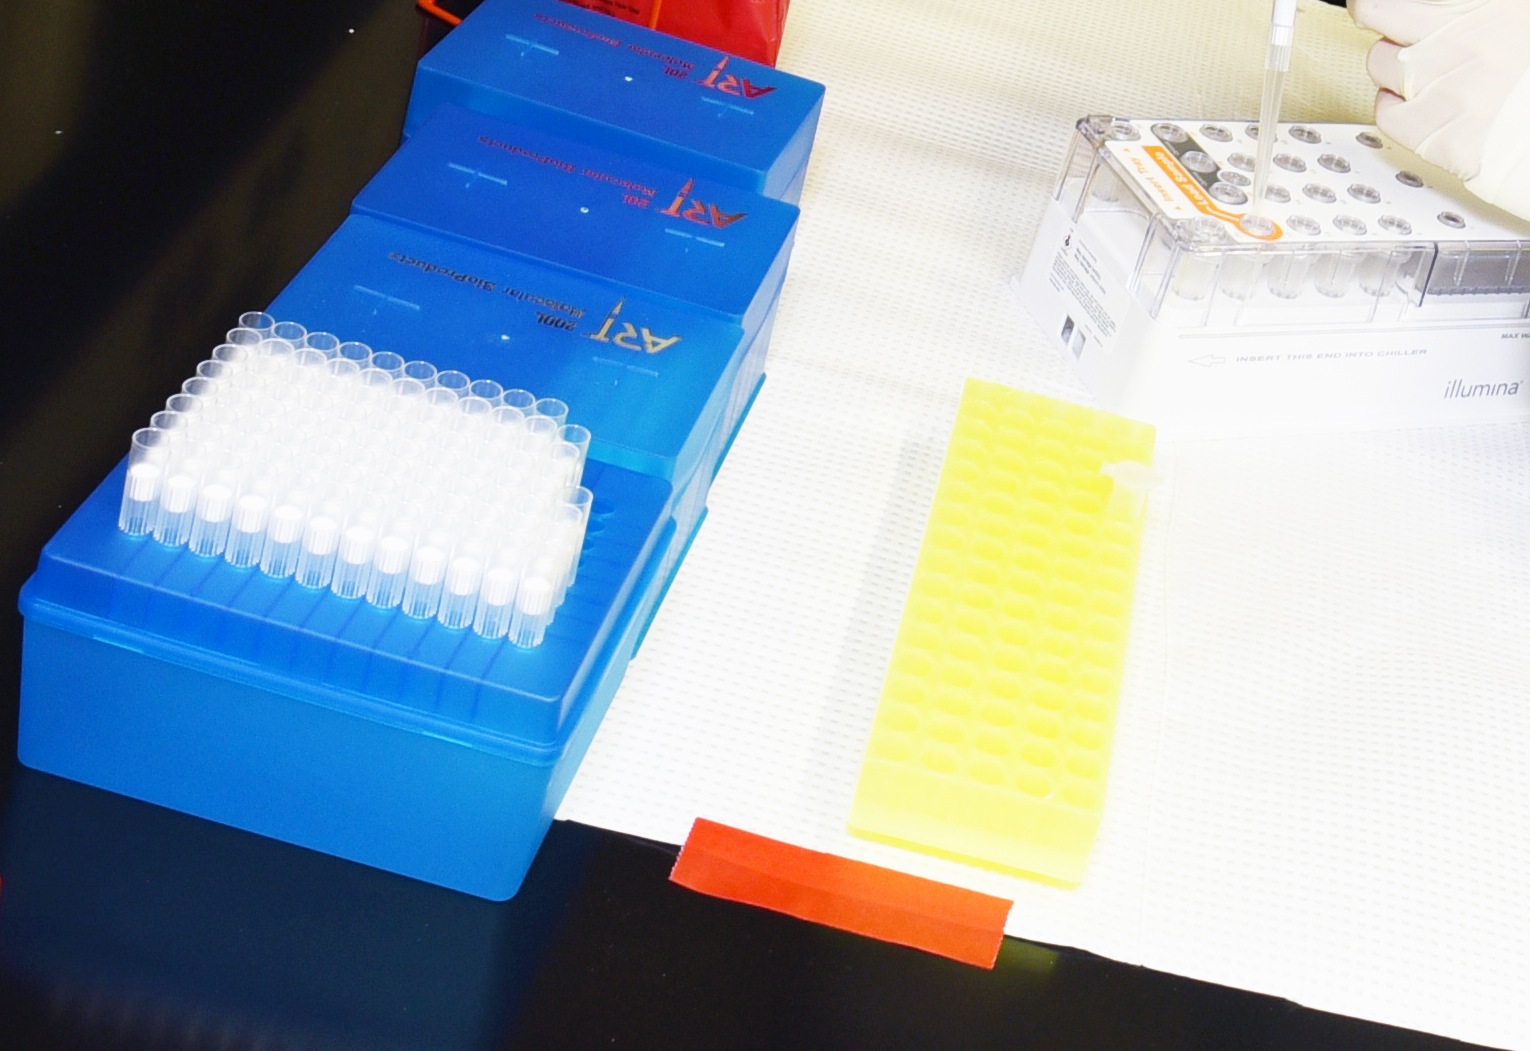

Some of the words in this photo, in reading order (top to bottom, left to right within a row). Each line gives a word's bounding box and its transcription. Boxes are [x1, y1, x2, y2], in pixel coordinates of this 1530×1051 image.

[698, 54, 778, 100] ART
[1129, 156, 1150, 175] Tray
[1154, 151, 1189, 183] Sample
[1145, 176, 1174, 202] Insert
[1181, 183, 1209, 206] Load
[656, 177, 748, 229] ART
[388, 251, 498, 292] BioProducts
[536, 310, 578, 333] 200L
[587, 296, 682, 354] ART
[1235, 353, 1283, 363] INSERT
[1286, 352, 1313, 361] THIS
[1316, 351, 1342, 360] END
[1344, 350, 1374, 359] INTO
[1376, 348, 1428, 358] CHILLER
[1443, 378, 1521, 400] illumina
